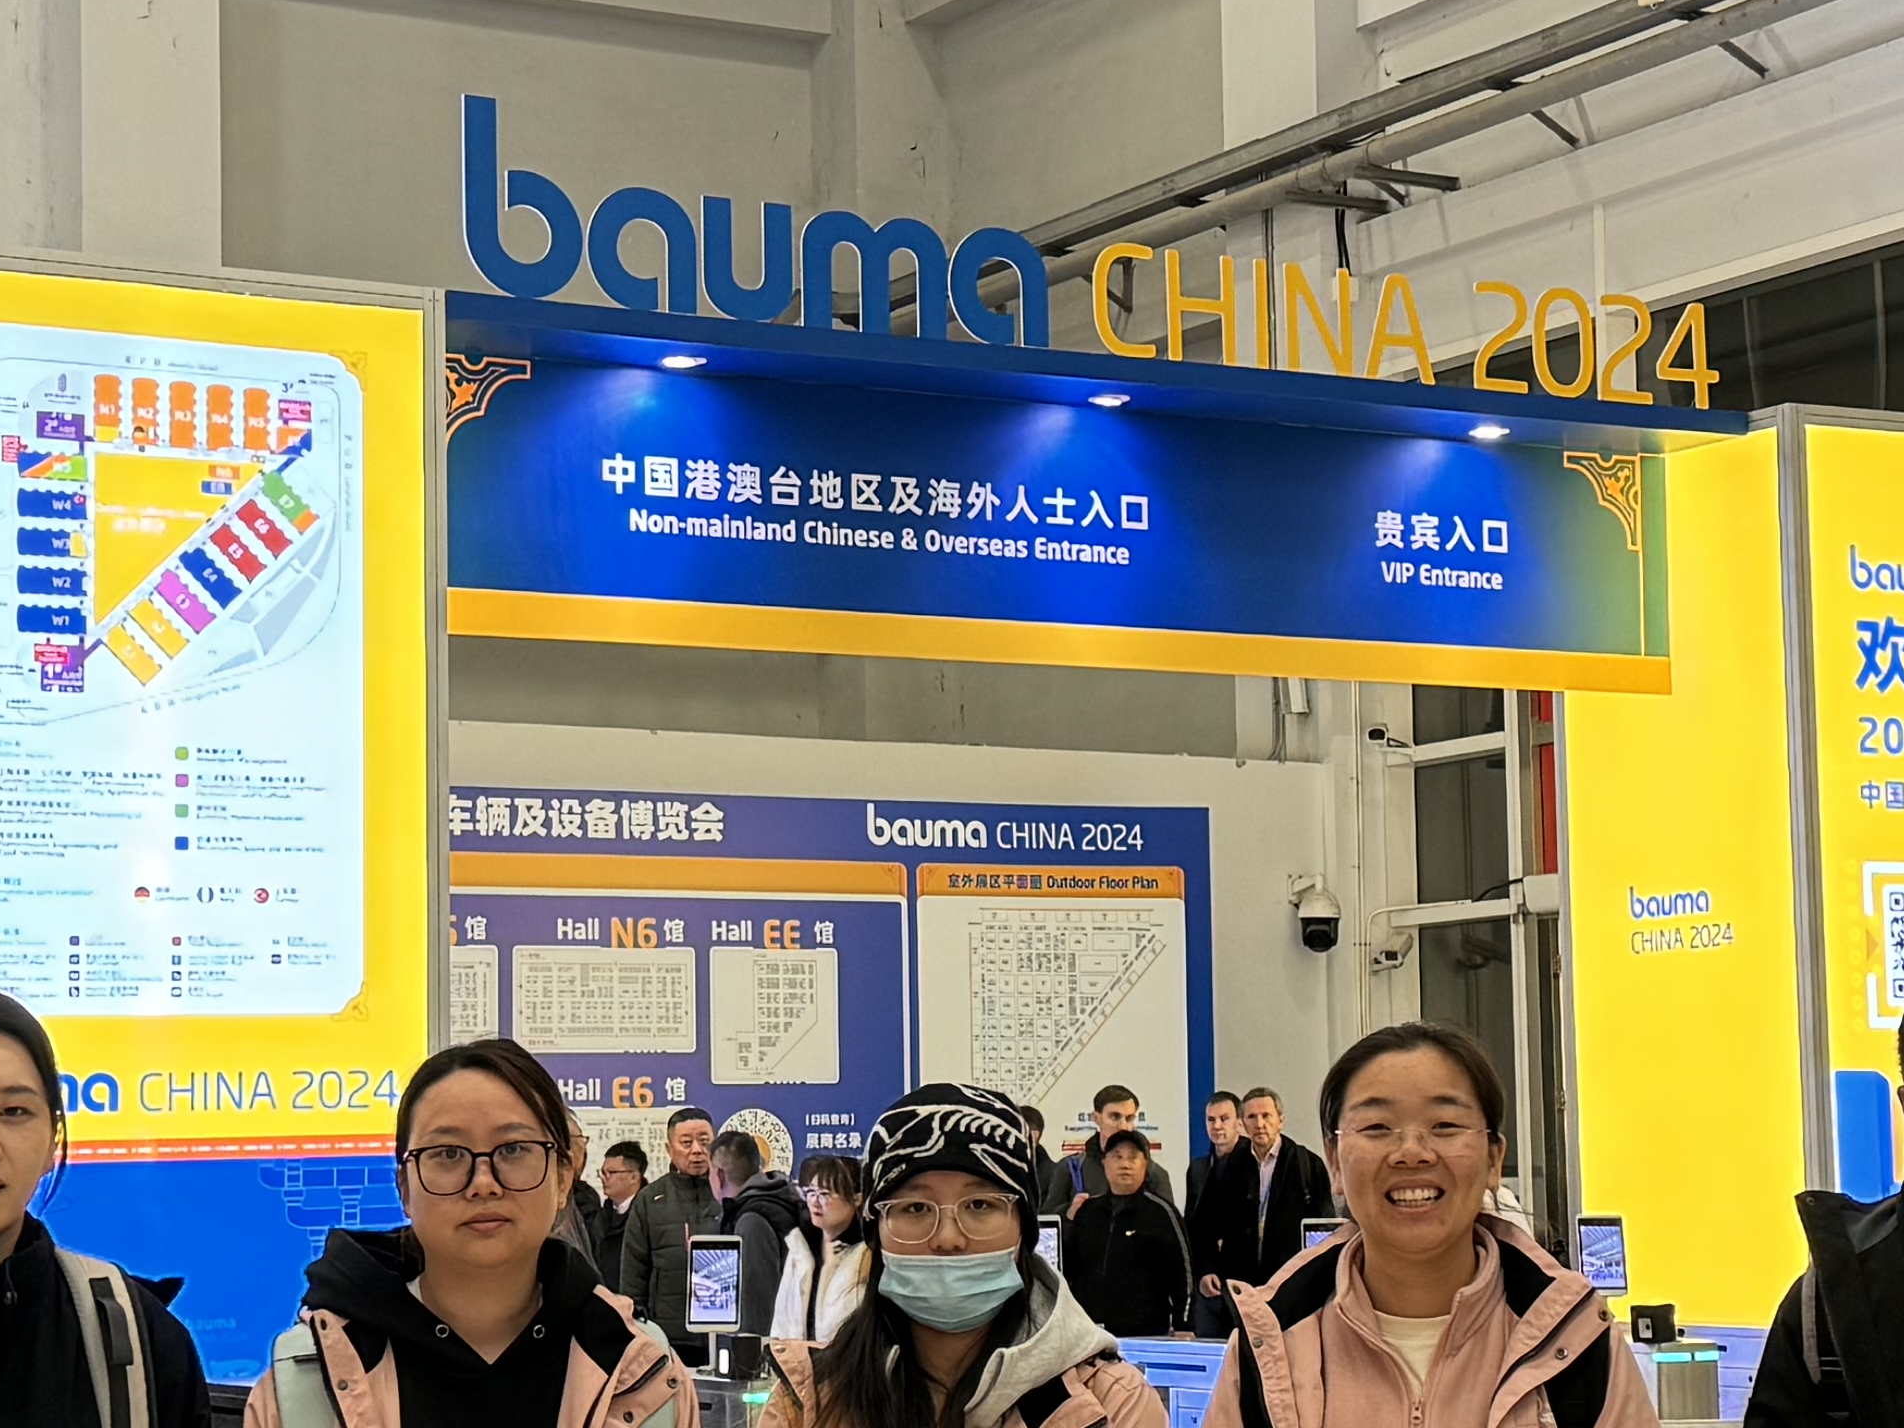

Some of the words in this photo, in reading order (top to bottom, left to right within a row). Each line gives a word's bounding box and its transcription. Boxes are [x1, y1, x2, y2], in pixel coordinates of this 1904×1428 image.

[461, 93, 1050, 348] bauma
[1092, 241, 1436, 386] CHINA
[1472, 278, 1720, 411] 2024
[600, 451, 1151, 532] 中国港澳台地区及海外人士入口
[627, 507, 797, 545] Non-mainland
[802, 514, 894, 550] Chinese
[900, 526, 919, 552] &
[923, 529, 1029, 560] Overseas
[1033, 535, 1130, 565] Entrance
[1373, 509, 1510, 554] 贵宾入口
[52, 576, 71, 588] W2
[1381, 560, 1415, 586] VIP
[1418, 562, 1504, 590] Entrance
[448, 793, 725, 842] 车辆及设备博览会
[866, 802, 988, 849] bauma
[996, 821, 1075, 851] CHINA
[1081, 823, 1145, 852] 2024
[1046, 875, 1096, 889] Outdoor
[1099, 876, 1130, 889] Floor
[1132, 876, 1159, 889] Plan
[1629, 885, 1709, 919] bauma
[464, 916, 487, 941] 馆
[557, 918, 600, 941] Hall
[610, 917, 658, 949] N6
[663, 918, 685, 943] 馆
[711, 920, 753, 942] Hall
[762, 919, 802, 949] EE
[814, 920, 835, 944] 馆
[1631, 927, 1684, 955] CHINA
[1690, 922, 1734, 949] 2024
[139, 1072, 277, 1112] CHINA
[291, 1070, 397, 1112] 2024
[559, 1077, 601, 1102] Hall
[612, 1076, 654, 1109] E6
[665, 1077, 686, 1102] 馆
